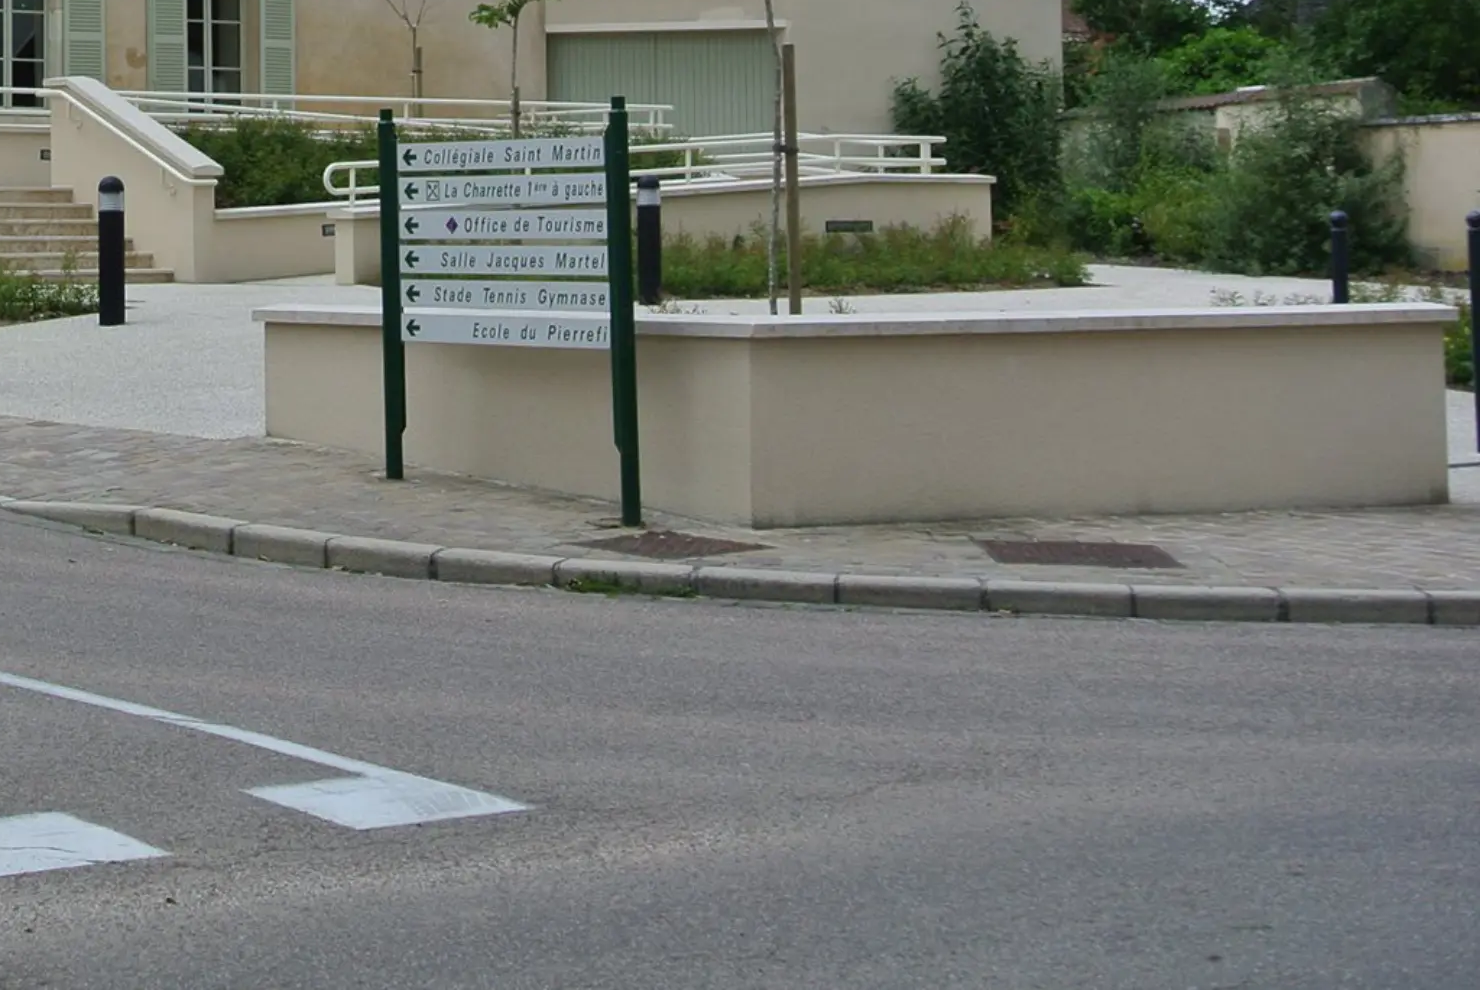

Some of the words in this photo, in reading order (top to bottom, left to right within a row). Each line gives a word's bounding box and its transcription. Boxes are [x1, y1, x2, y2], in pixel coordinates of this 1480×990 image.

[424, 147, 495, 168] Collégiale
[503, 145, 541, 163] Saint
[552, 143, 601, 161] Martin
[444, 182, 458, 199] La
[463, 181, 521, 198] Charrette
[551, 180, 559, 197] à
[565, 179, 603, 200] gauche
[463, 216, 507, 233] Office
[514, 216, 530, 233] de
[537, 215, 604, 233] Tourisme
[440, 251, 476, 268] Salle
[486, 252, 545, 272] Jacques
[555, 252, 605, 270] Martel
[434, 286, 472, 304] Stade
[483, 287, 527, 305] Tennis
[538, 288, 606, 308] Gymnase
[473, 322, 510, 340] Ecole
[520, 323, 537, 341] du
